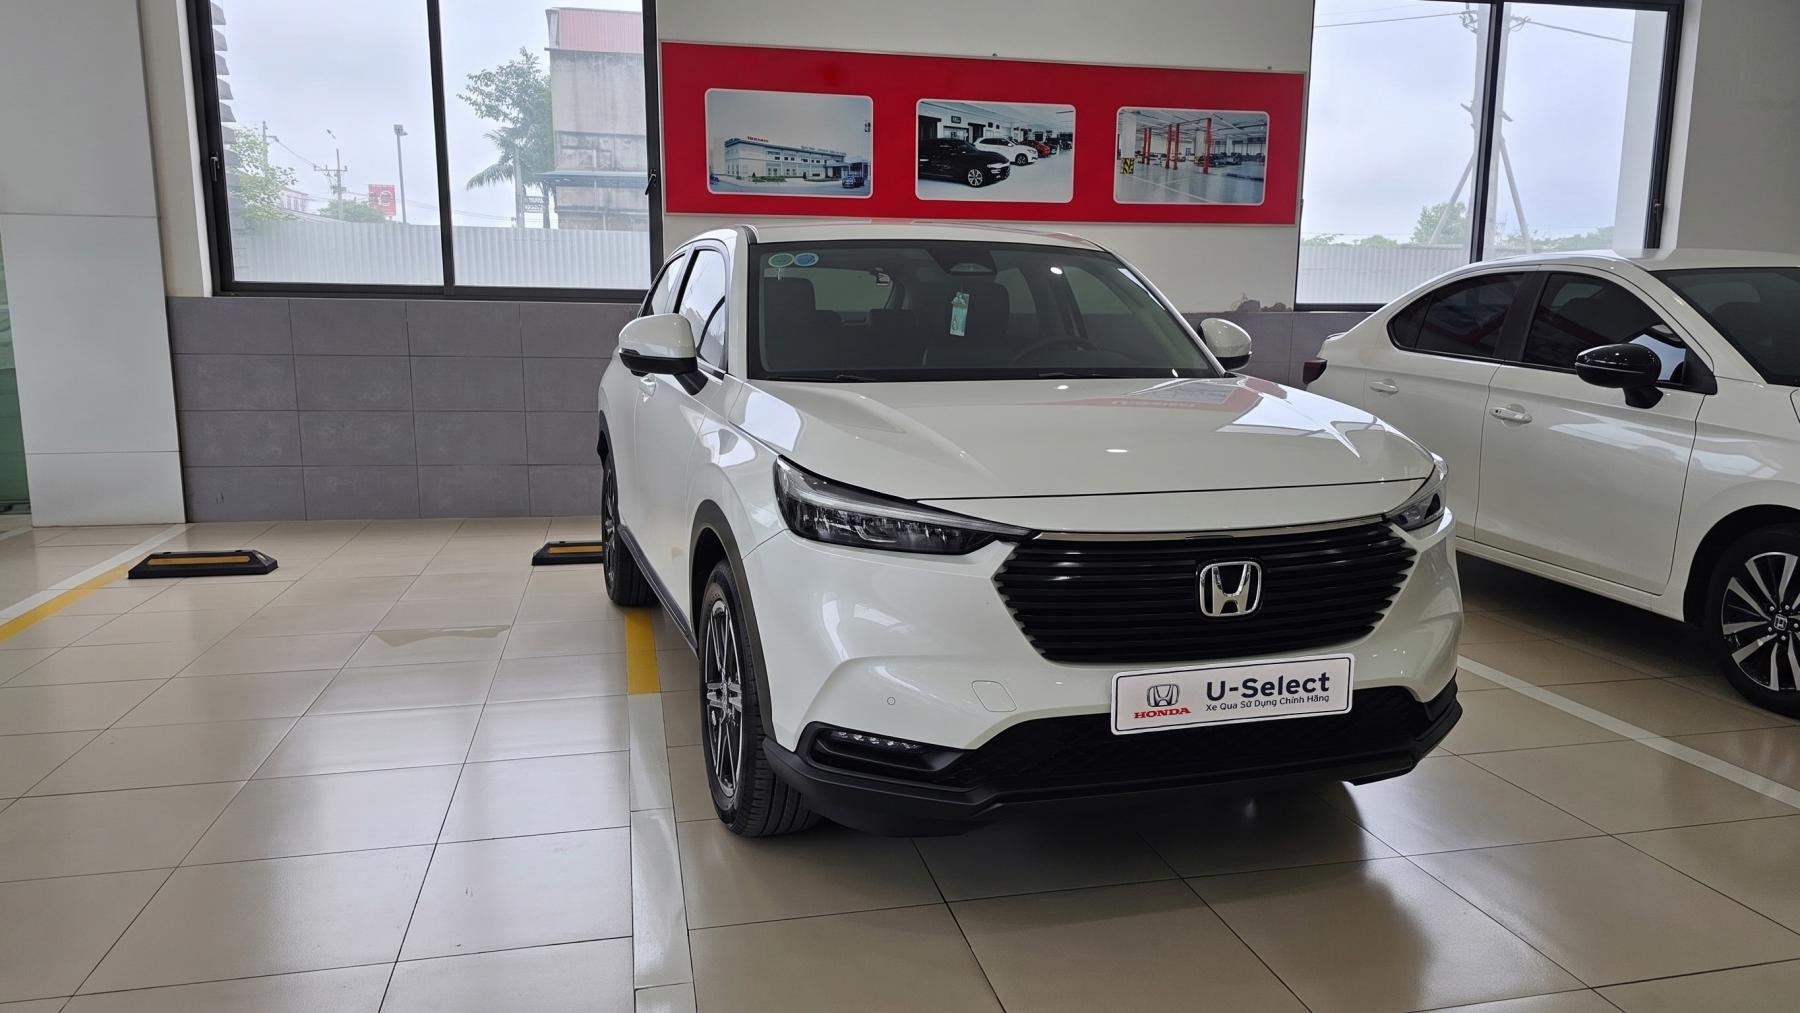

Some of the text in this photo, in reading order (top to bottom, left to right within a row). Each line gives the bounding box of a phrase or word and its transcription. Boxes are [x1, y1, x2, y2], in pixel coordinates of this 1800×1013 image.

[1207, 672, 1330, 701] U-Select
[1220, 702, 1238, 711] Qua
[1255, 699, 1277, 708] Dụng
[1280, 696, 1305, 705] Chính
[1307, 694, 1330, 703] Hãng
[1134, 707, 1191, 719] HONDA
